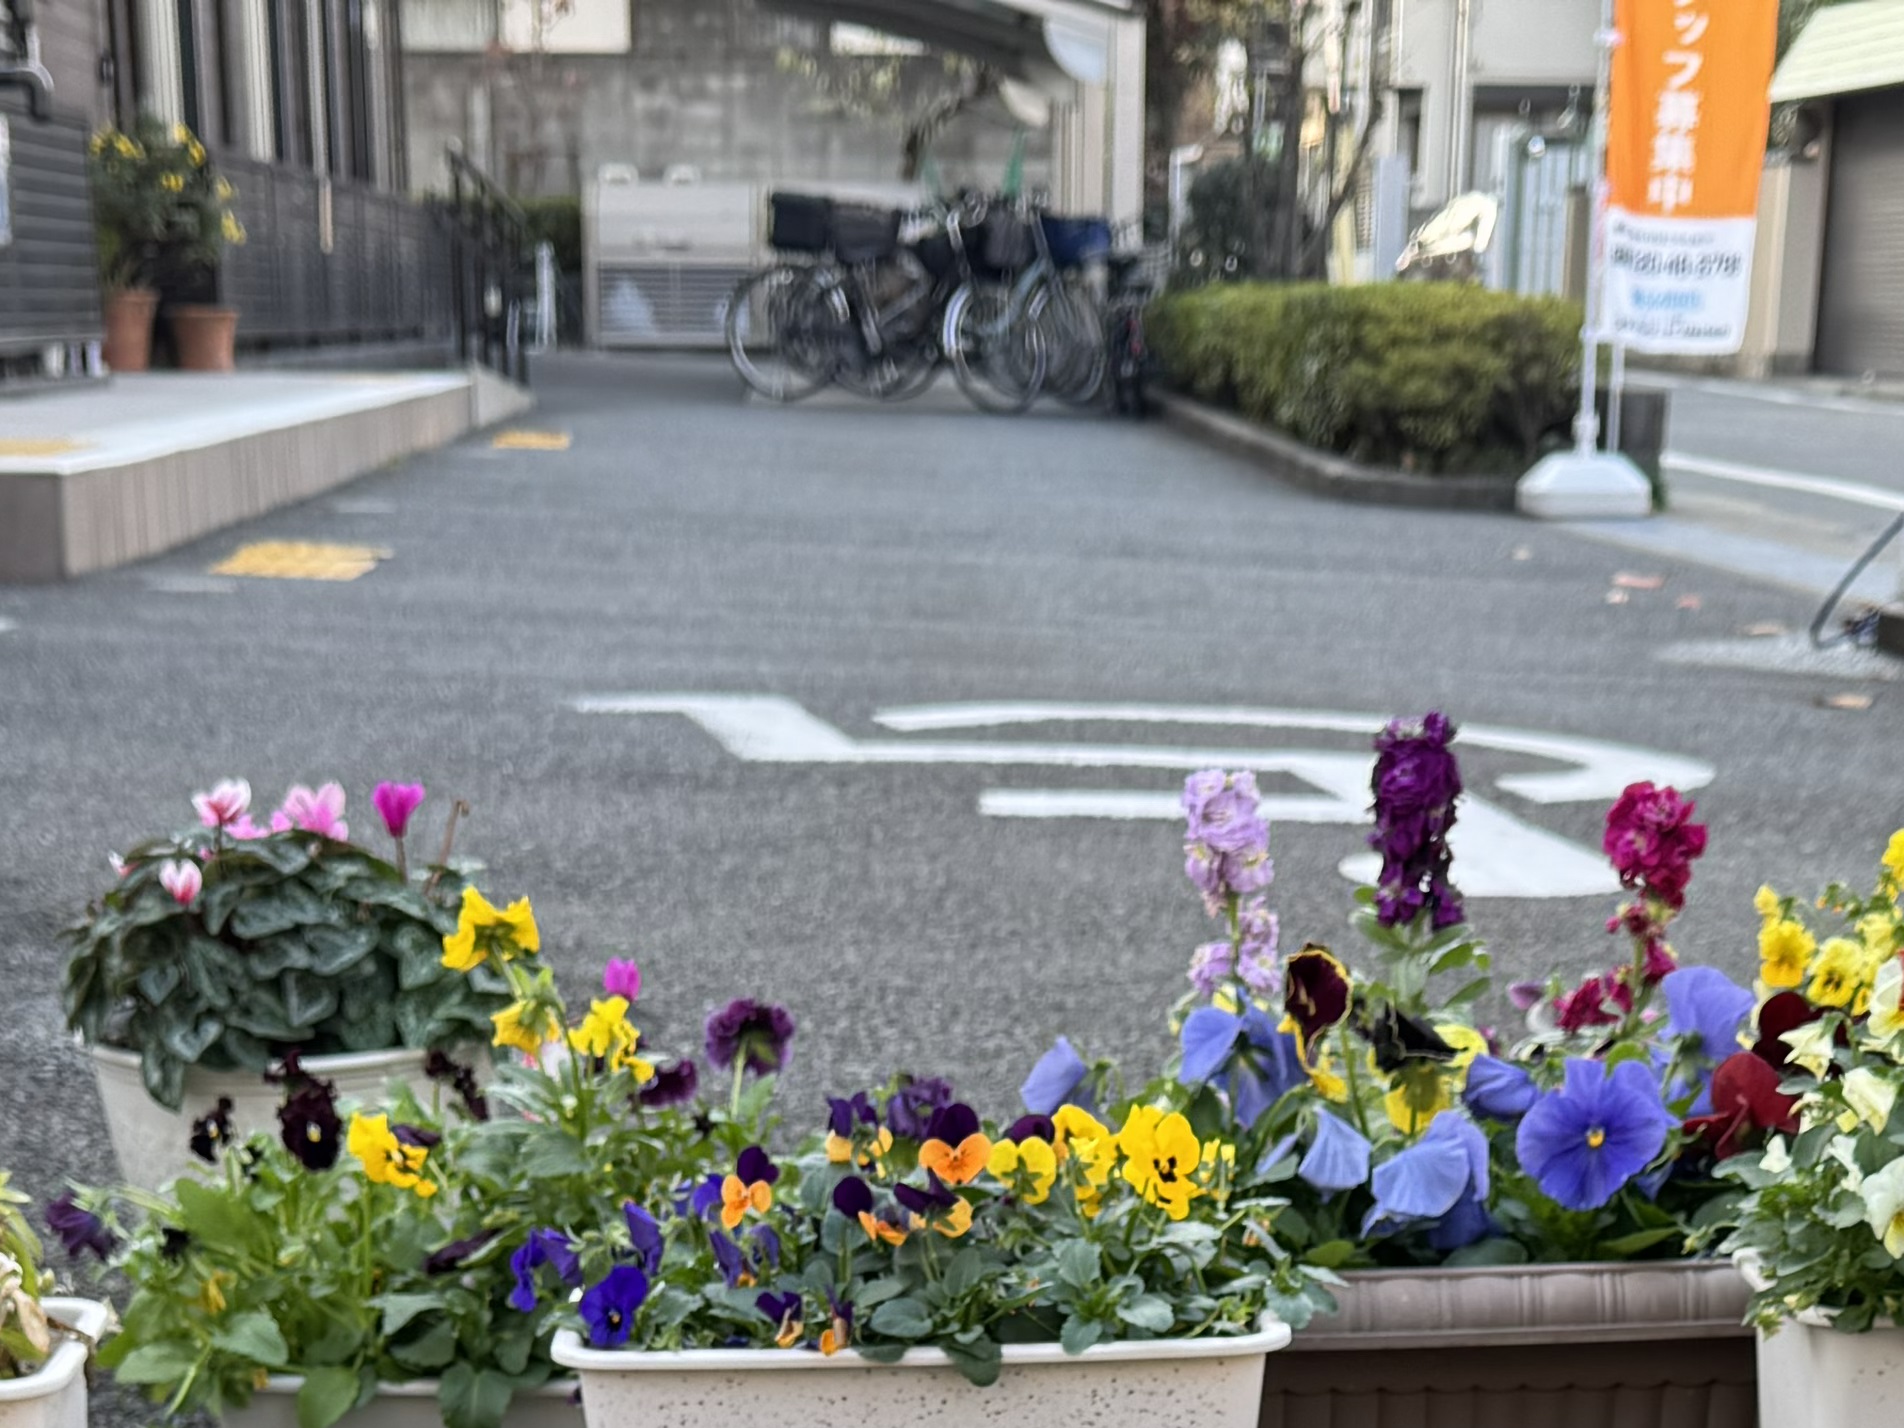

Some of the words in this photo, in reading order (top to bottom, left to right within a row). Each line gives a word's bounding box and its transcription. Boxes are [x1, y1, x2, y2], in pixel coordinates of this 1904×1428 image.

[1648, 0, 1709, 214] ッフ募集中
